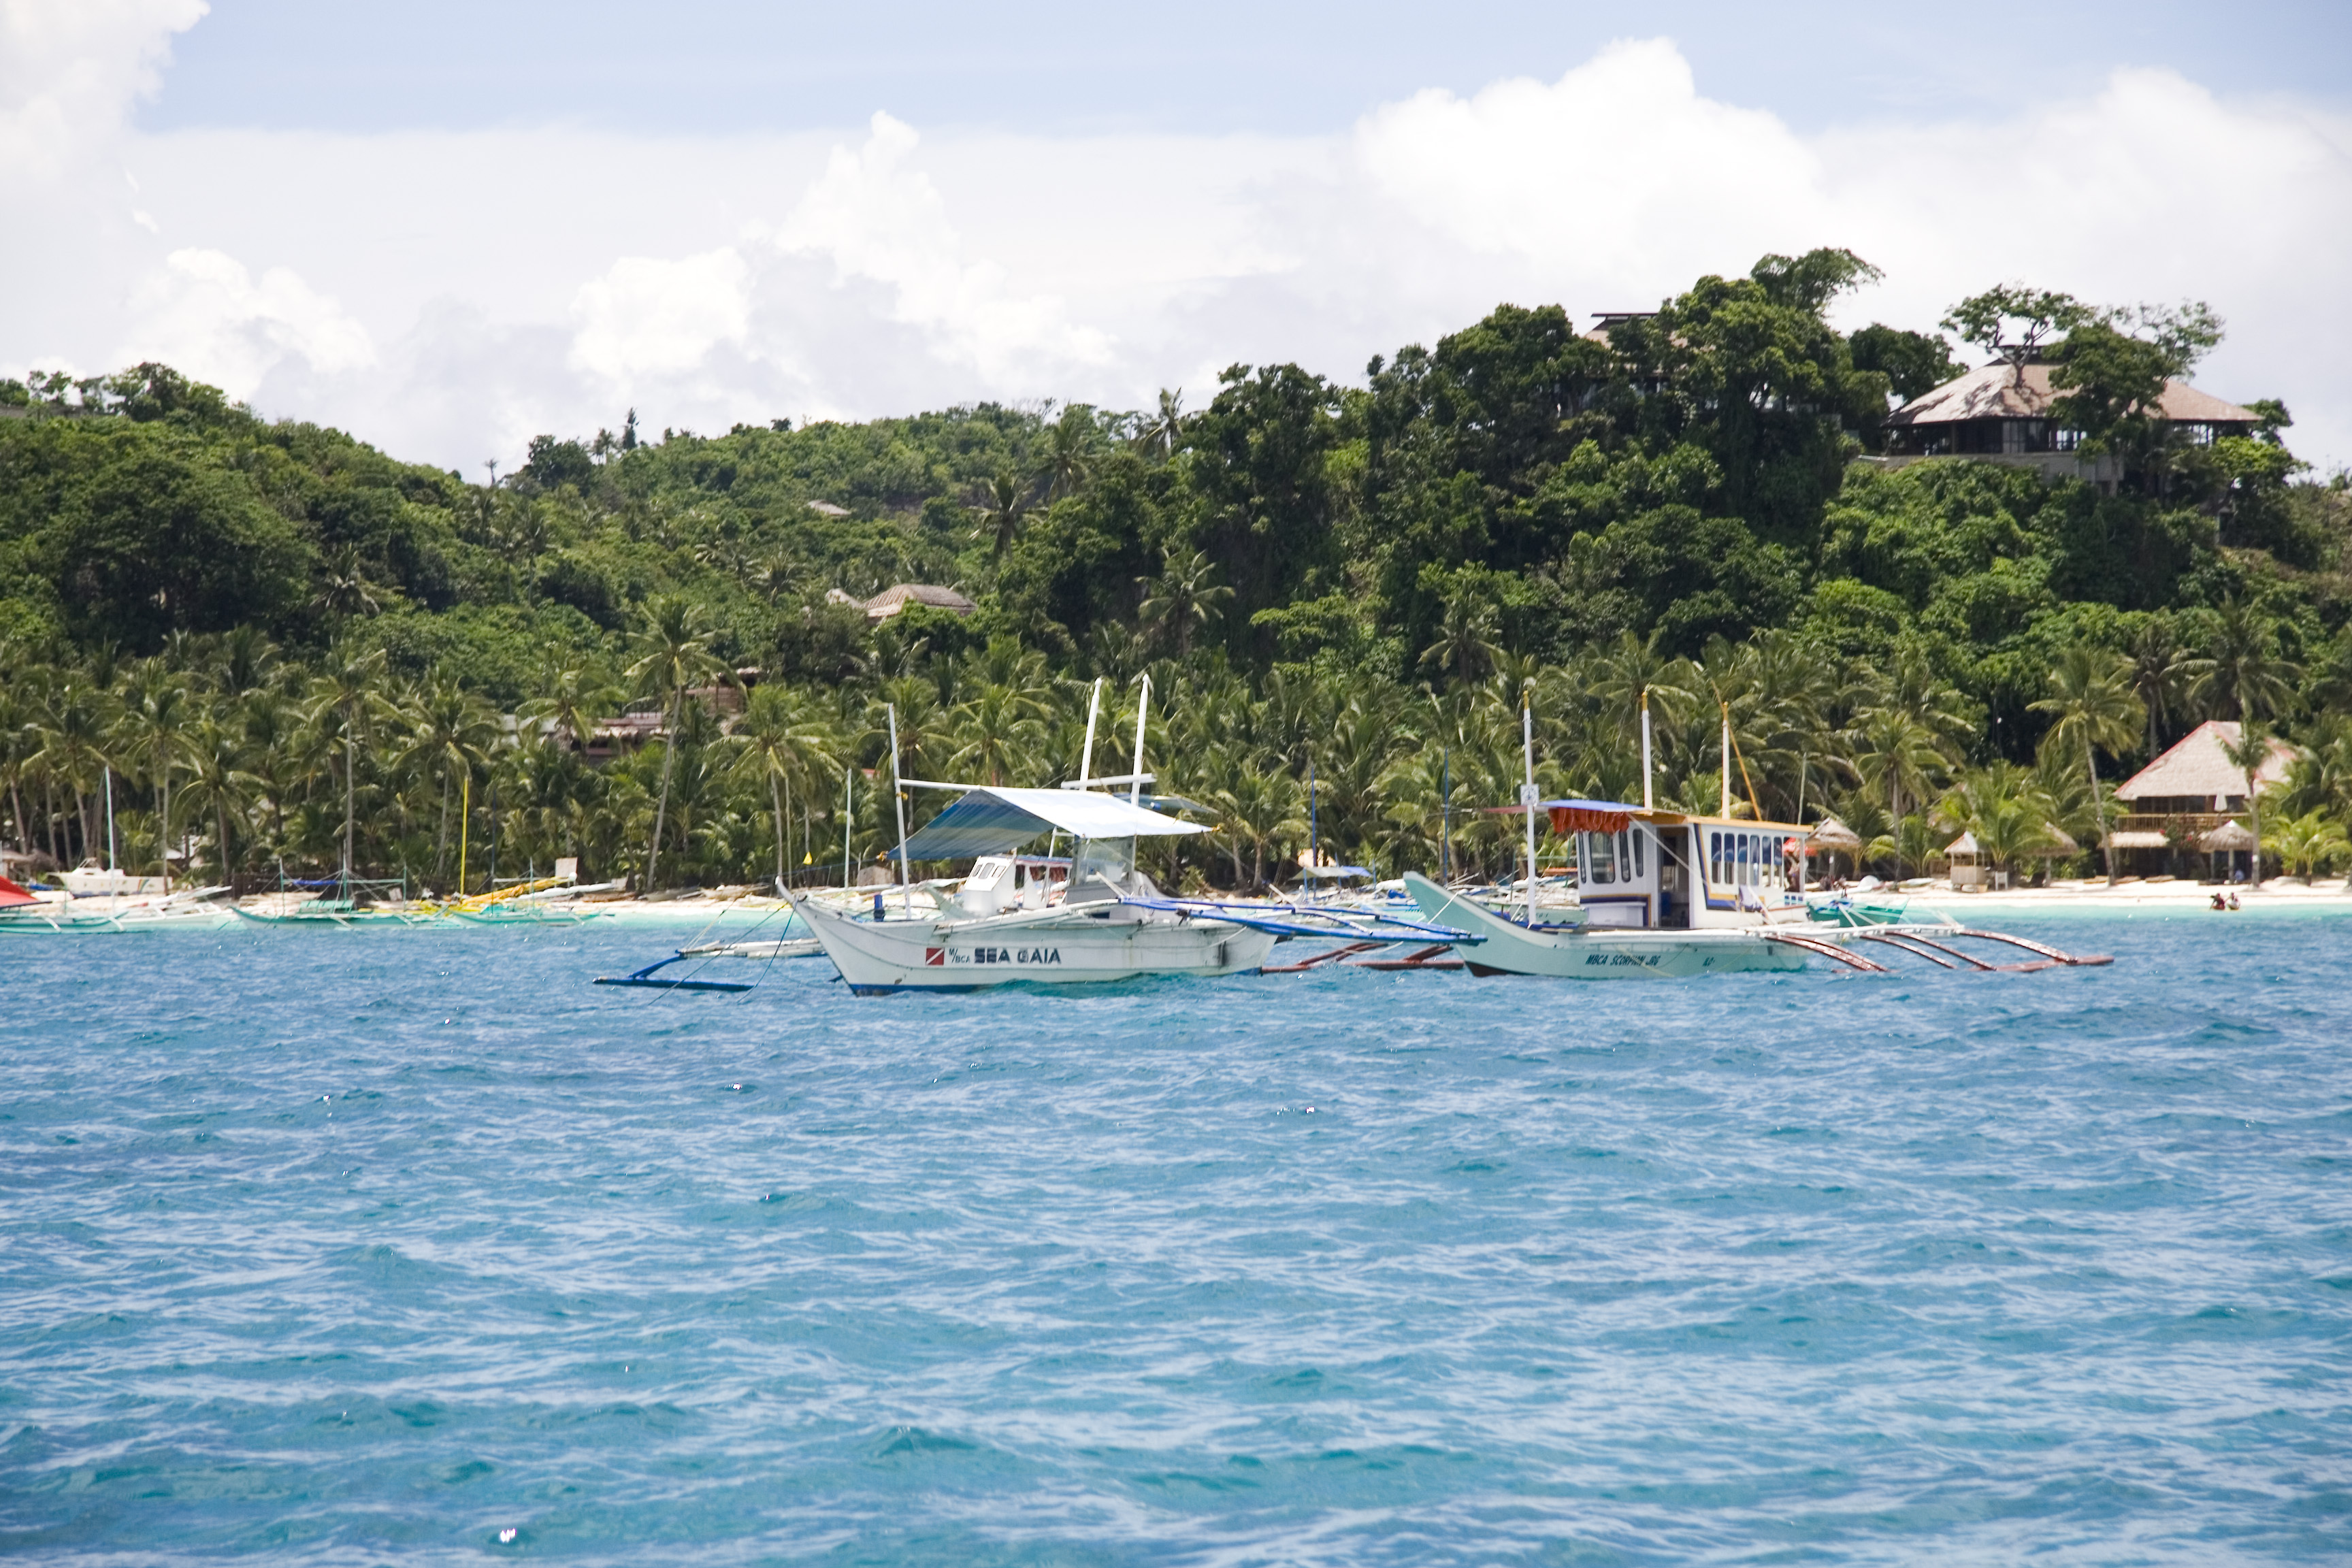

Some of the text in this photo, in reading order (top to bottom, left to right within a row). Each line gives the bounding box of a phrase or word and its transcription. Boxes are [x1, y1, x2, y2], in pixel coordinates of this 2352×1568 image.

[975, 947, 1011, 964] SEA
[1017, 947, 1062, 964] GAIA
[1586, 954, 1609, 965] MBCA
